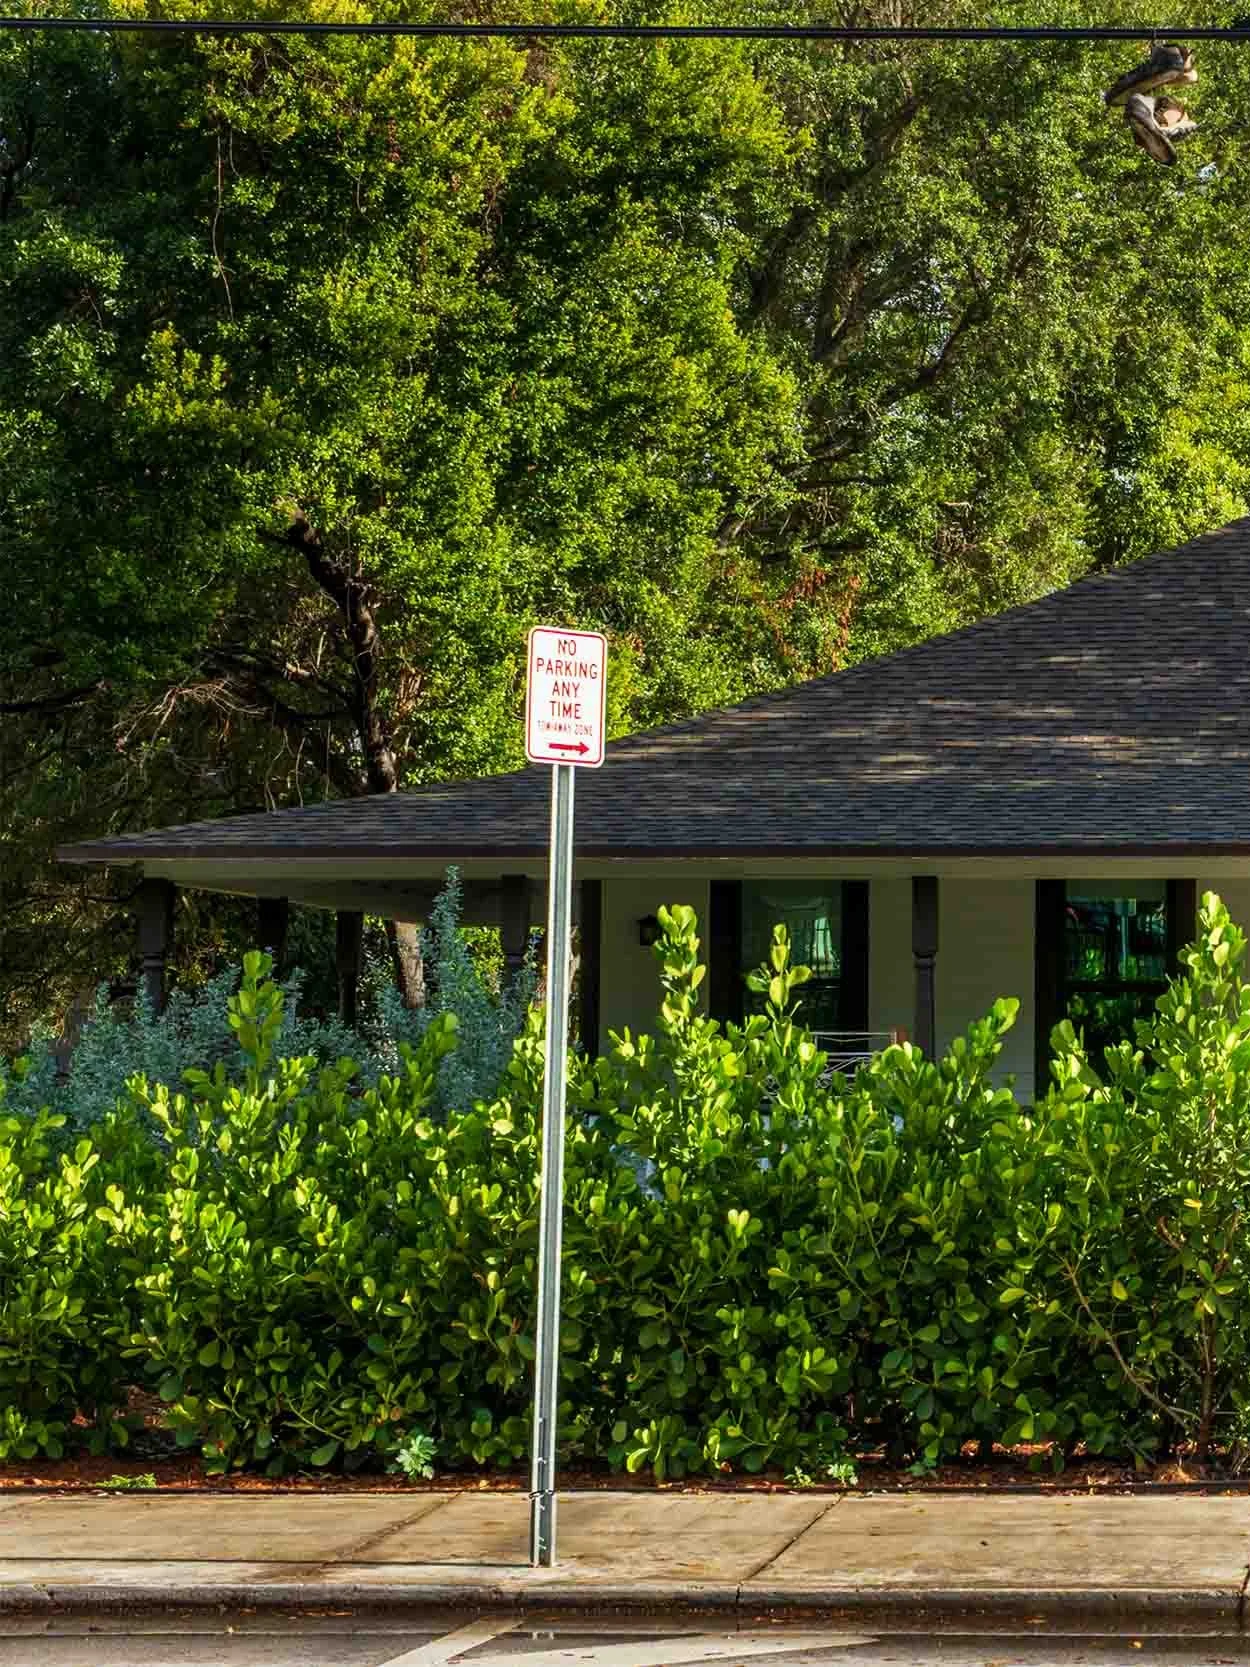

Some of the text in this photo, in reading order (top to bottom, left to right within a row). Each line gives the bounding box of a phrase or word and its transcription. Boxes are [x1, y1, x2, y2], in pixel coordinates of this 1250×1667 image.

[558, 639, 577, 656] NO
[536, 657, 598, 680] PARKING
[552, 680, 580, 698] ANY
[549, 700, 582, 720] TIME
